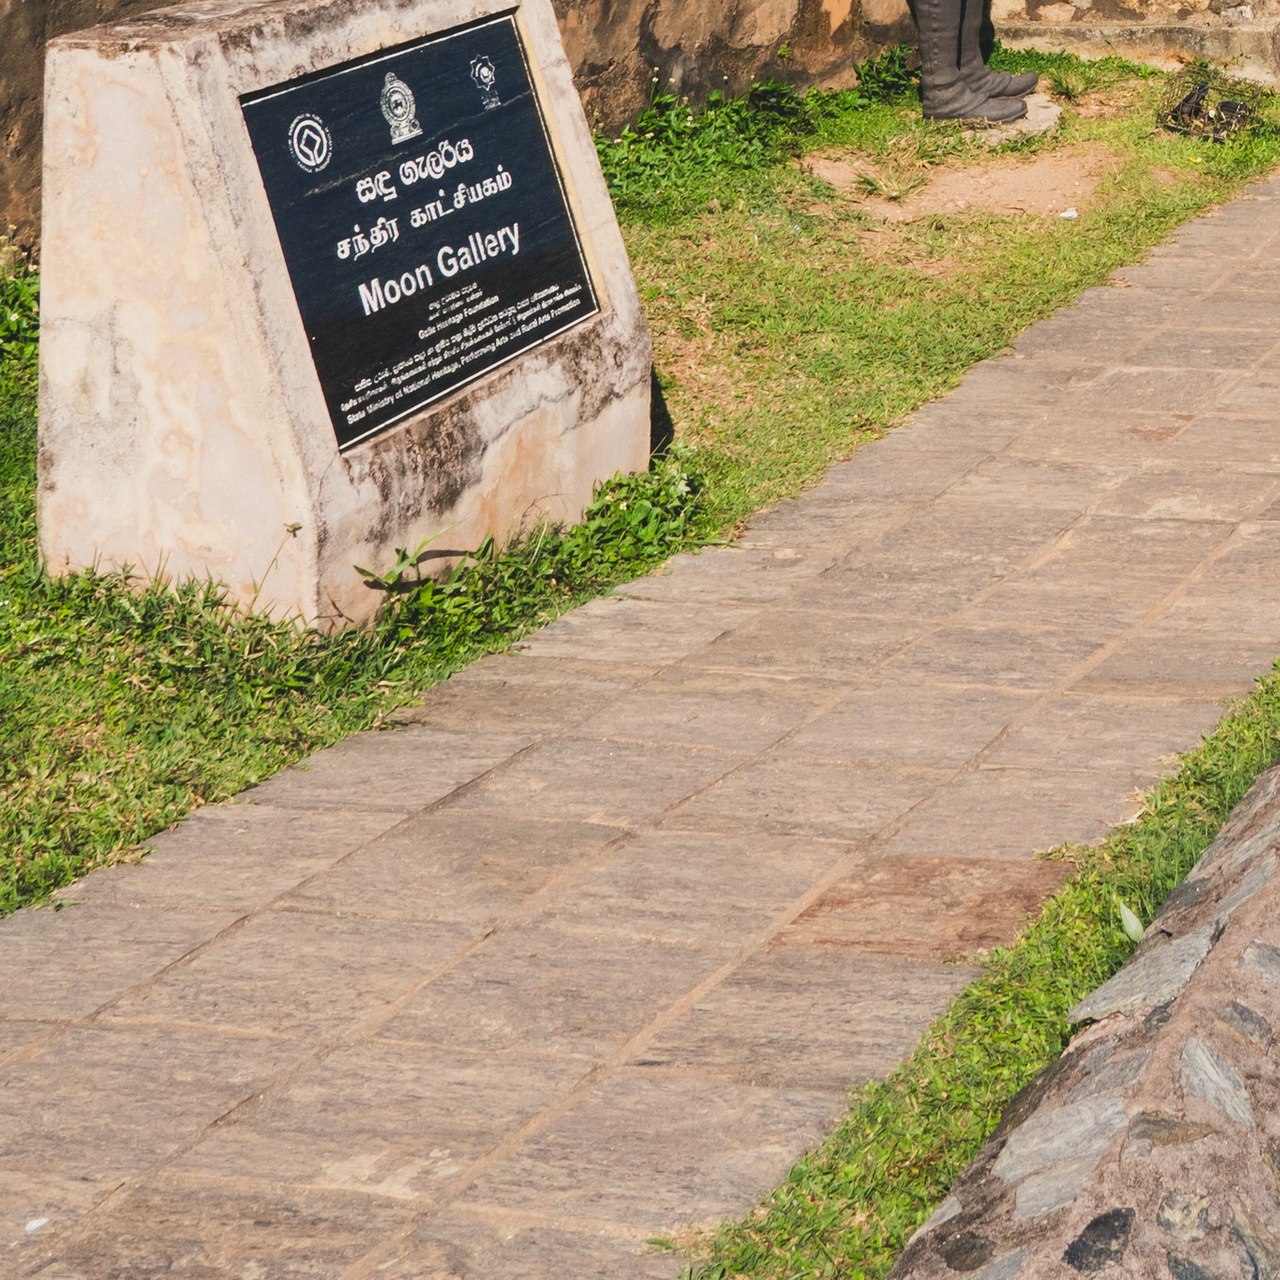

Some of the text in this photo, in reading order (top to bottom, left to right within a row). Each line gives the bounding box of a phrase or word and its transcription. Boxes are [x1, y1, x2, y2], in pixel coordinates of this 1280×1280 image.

[336, 163, 513, 261] சந்திர காட்சியகம்
[357, 222, 520, 316] Moon Gallery
[463, 295, 499, 317] Foundation
[346, 410, 366, 425] State
[366, 395, 395, 414] Ministry
[395, 389, 403, 399] of
[402, 373, 431, 395] National
[460, 342, 496, 365] Performing
[495, 335, 509, 347] Arts
[509, 327, 522, 340] and
[521, 318, 538, 333] Rural
[538, 314, 551, 325] Arts
[550, 298, 581, 318] Promotion
